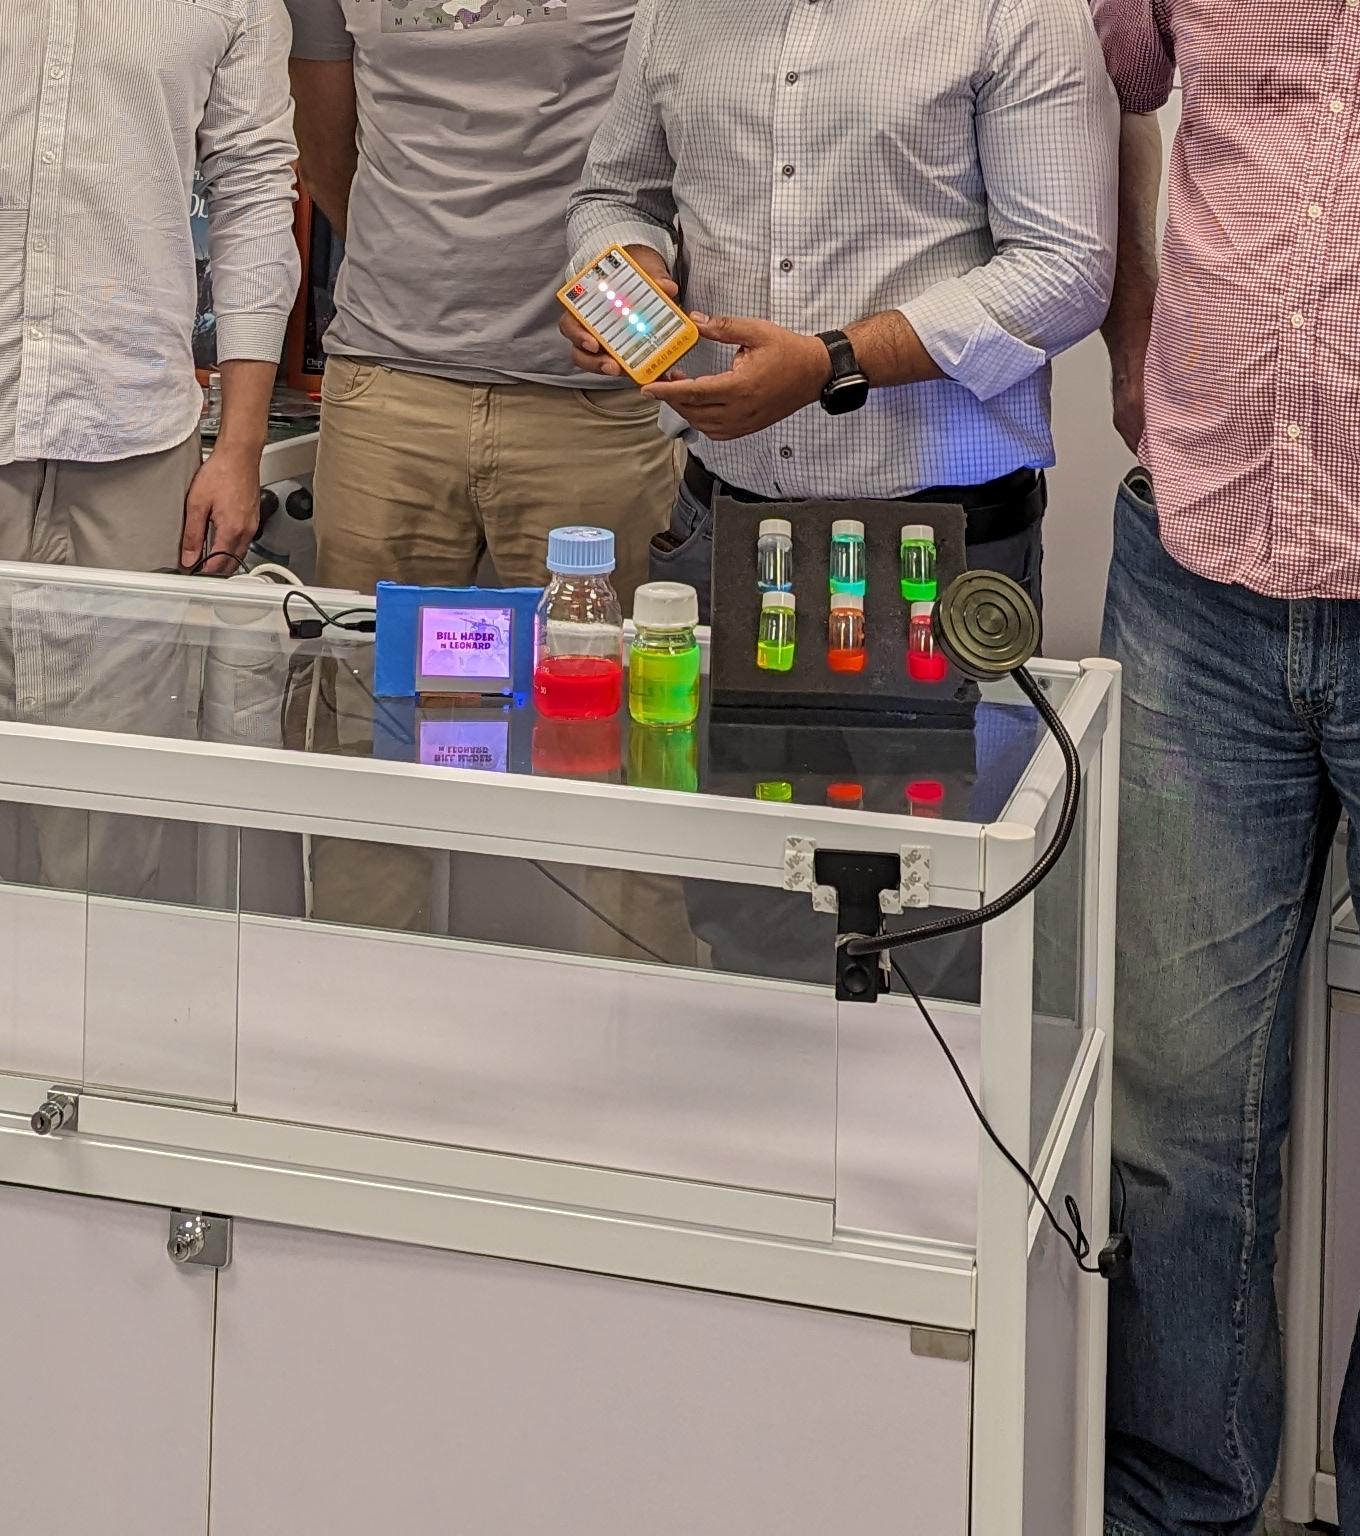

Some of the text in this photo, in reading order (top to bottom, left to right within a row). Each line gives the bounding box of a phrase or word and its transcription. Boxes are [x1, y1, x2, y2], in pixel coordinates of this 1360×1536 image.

[394, 7, 551, 26] MY NEW LIFE
[436, 631, 495, 642] BILL HADER
[449, 641, 491, 650] LEONARD
[902, 849, 921, 869] 3M
[902, 871, 921, 891] 3M
